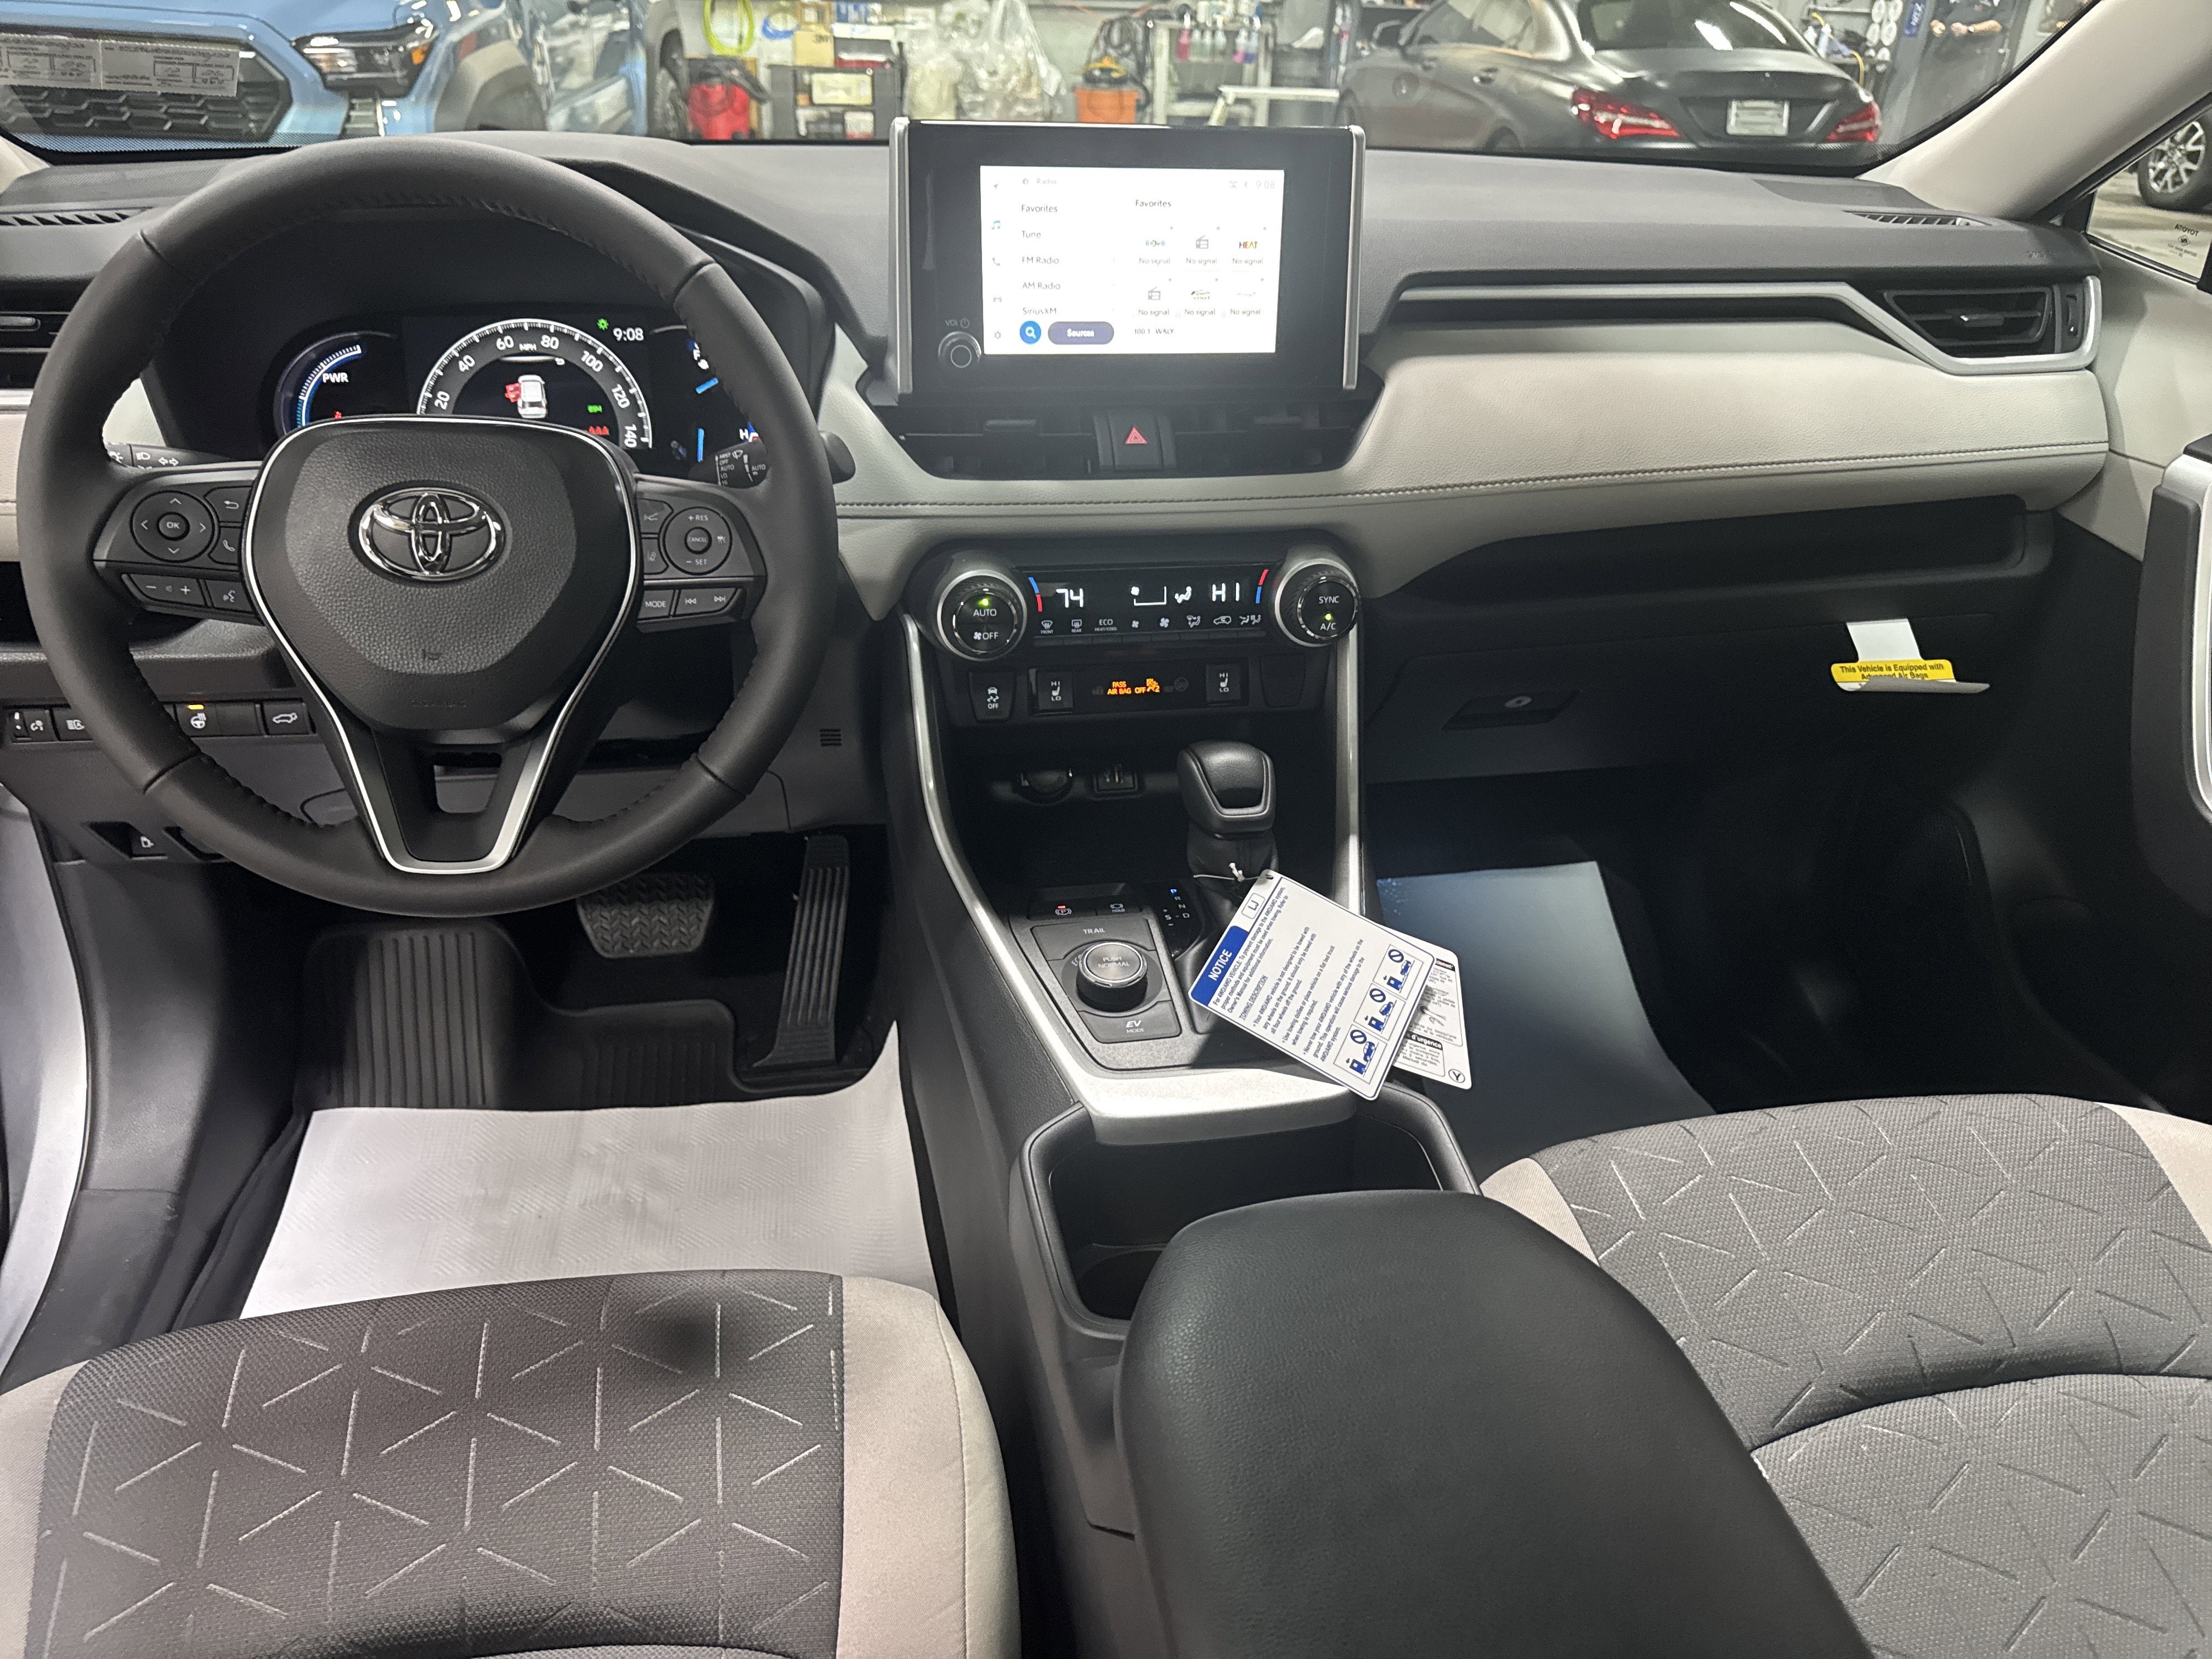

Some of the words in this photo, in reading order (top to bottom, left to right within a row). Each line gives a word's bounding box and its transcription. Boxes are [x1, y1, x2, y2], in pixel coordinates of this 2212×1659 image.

[1021, 205, 1058, 213] Favorites
[1151, 257, 1171, 266] signal
[1198, 257, 1217, 266] signal
[1245, 257, 1263, 266] signal
[1150, 308, 1169, 317] signal
[1196, 308, 1215, 317] signal
[1242, 308, 1261, 317] signal
[613, 328, 644, 342] 9:08
[1067, 329, 1094, 337] Sources
[496, 336, 514, 350] 60
[540, 335, 559, 349] 80
[458, 354, 475, 372] 40
[580, 350, 603, 373] 100
[323, 372, 348, 383] PWR
[435, 391, 450, 409] 20
[612, 384, 630, 408] 120
[624, 424, 637, 448] 140
[740, 428, 749, 439] H
[1056, 589, 1084, 608] 74
[1212, 583, 1239, 601] HI
[1321, 622, 1336, 630] A/C
[1857, 664, 1884, 673] Vehicle
[1894, 663, 1927, 673] Equipped
[1910, 671, 1929, 680] Bags
[1212, 996, 1221, 1005] For
[1217, 977, 1232, 998] 4WD/AWD
[1242, 940, 1254, 956] prevent
[1250, 926, 1262, 941] damage
[1264, 898, 1278, 917] 4WD/AWD
[1348, 950, 1358, 963] wheels
[1207, 948, 1233, 981] NOTICE
[1220, 995, 1232, 1010] proper
[1228, 979, 1240, 996] methods
[1242, 953, 1256, 973] equipment
[1260, 929, 1268, 940] used
[1265, 920, 1273, 930] when
[1227, 995, 1240, 1013] Owner's
[1236, 982, 1248, 997] Manual
[1247, 958, 1261, 977] additional
[1253, 1013, 1262, 1024] Your
[1258, 994, 1273, 1015] 4WD/AWD
[1269, 980, 1280, 995] vehicle
[1282, 953, 1296, 972] designed
[1296, 933, 1305, 945] towed
[1266, 1007, 1277, 1022] wheels
[1289, 964, 1300, 978] should
[1296, 956, 1305, 966] only
[1303, 940, 1312, 952] towed
[1239, 1001, 1252, 1020] TOWING
[1248, 974, 1268, 1003] DESCRIPTION
[1282, 1031, 1290, 1041] Use
[1286, 1018, 1298, 1033] towing
[1303, 989, 1312, 1001] place
[1308, 976, 1318, 990] vehicle
[1327, 945, 1335, 955] truck
[1328, 989, 1338, 1003] vehicle
[1319, 1031, 1328, 1041] This
[1324, 1013, 1338, 1033] operation
[1337, 995, 1346, 1007] cause
[1342, 981, 1352, 996] serious
[1349, 967, 1361, 983] damage
[1277, 1005, 1288, 1020] wheels
[1317, 1002, 1331, 1023] 4WD/AWD
[1290, 1033, 1300, 1046] when
[1296, 1020, 1308, 1035] towing
[1314, 1022, 1323, 1032] your
[1303, 1039, 1313, 1053] Never
[1410, 1034, 1442, 1049] d'urgence
[1319, 1040, 1334, 1062] 4WD/AWD
[1451, 1071, 1460, 1081] Y
